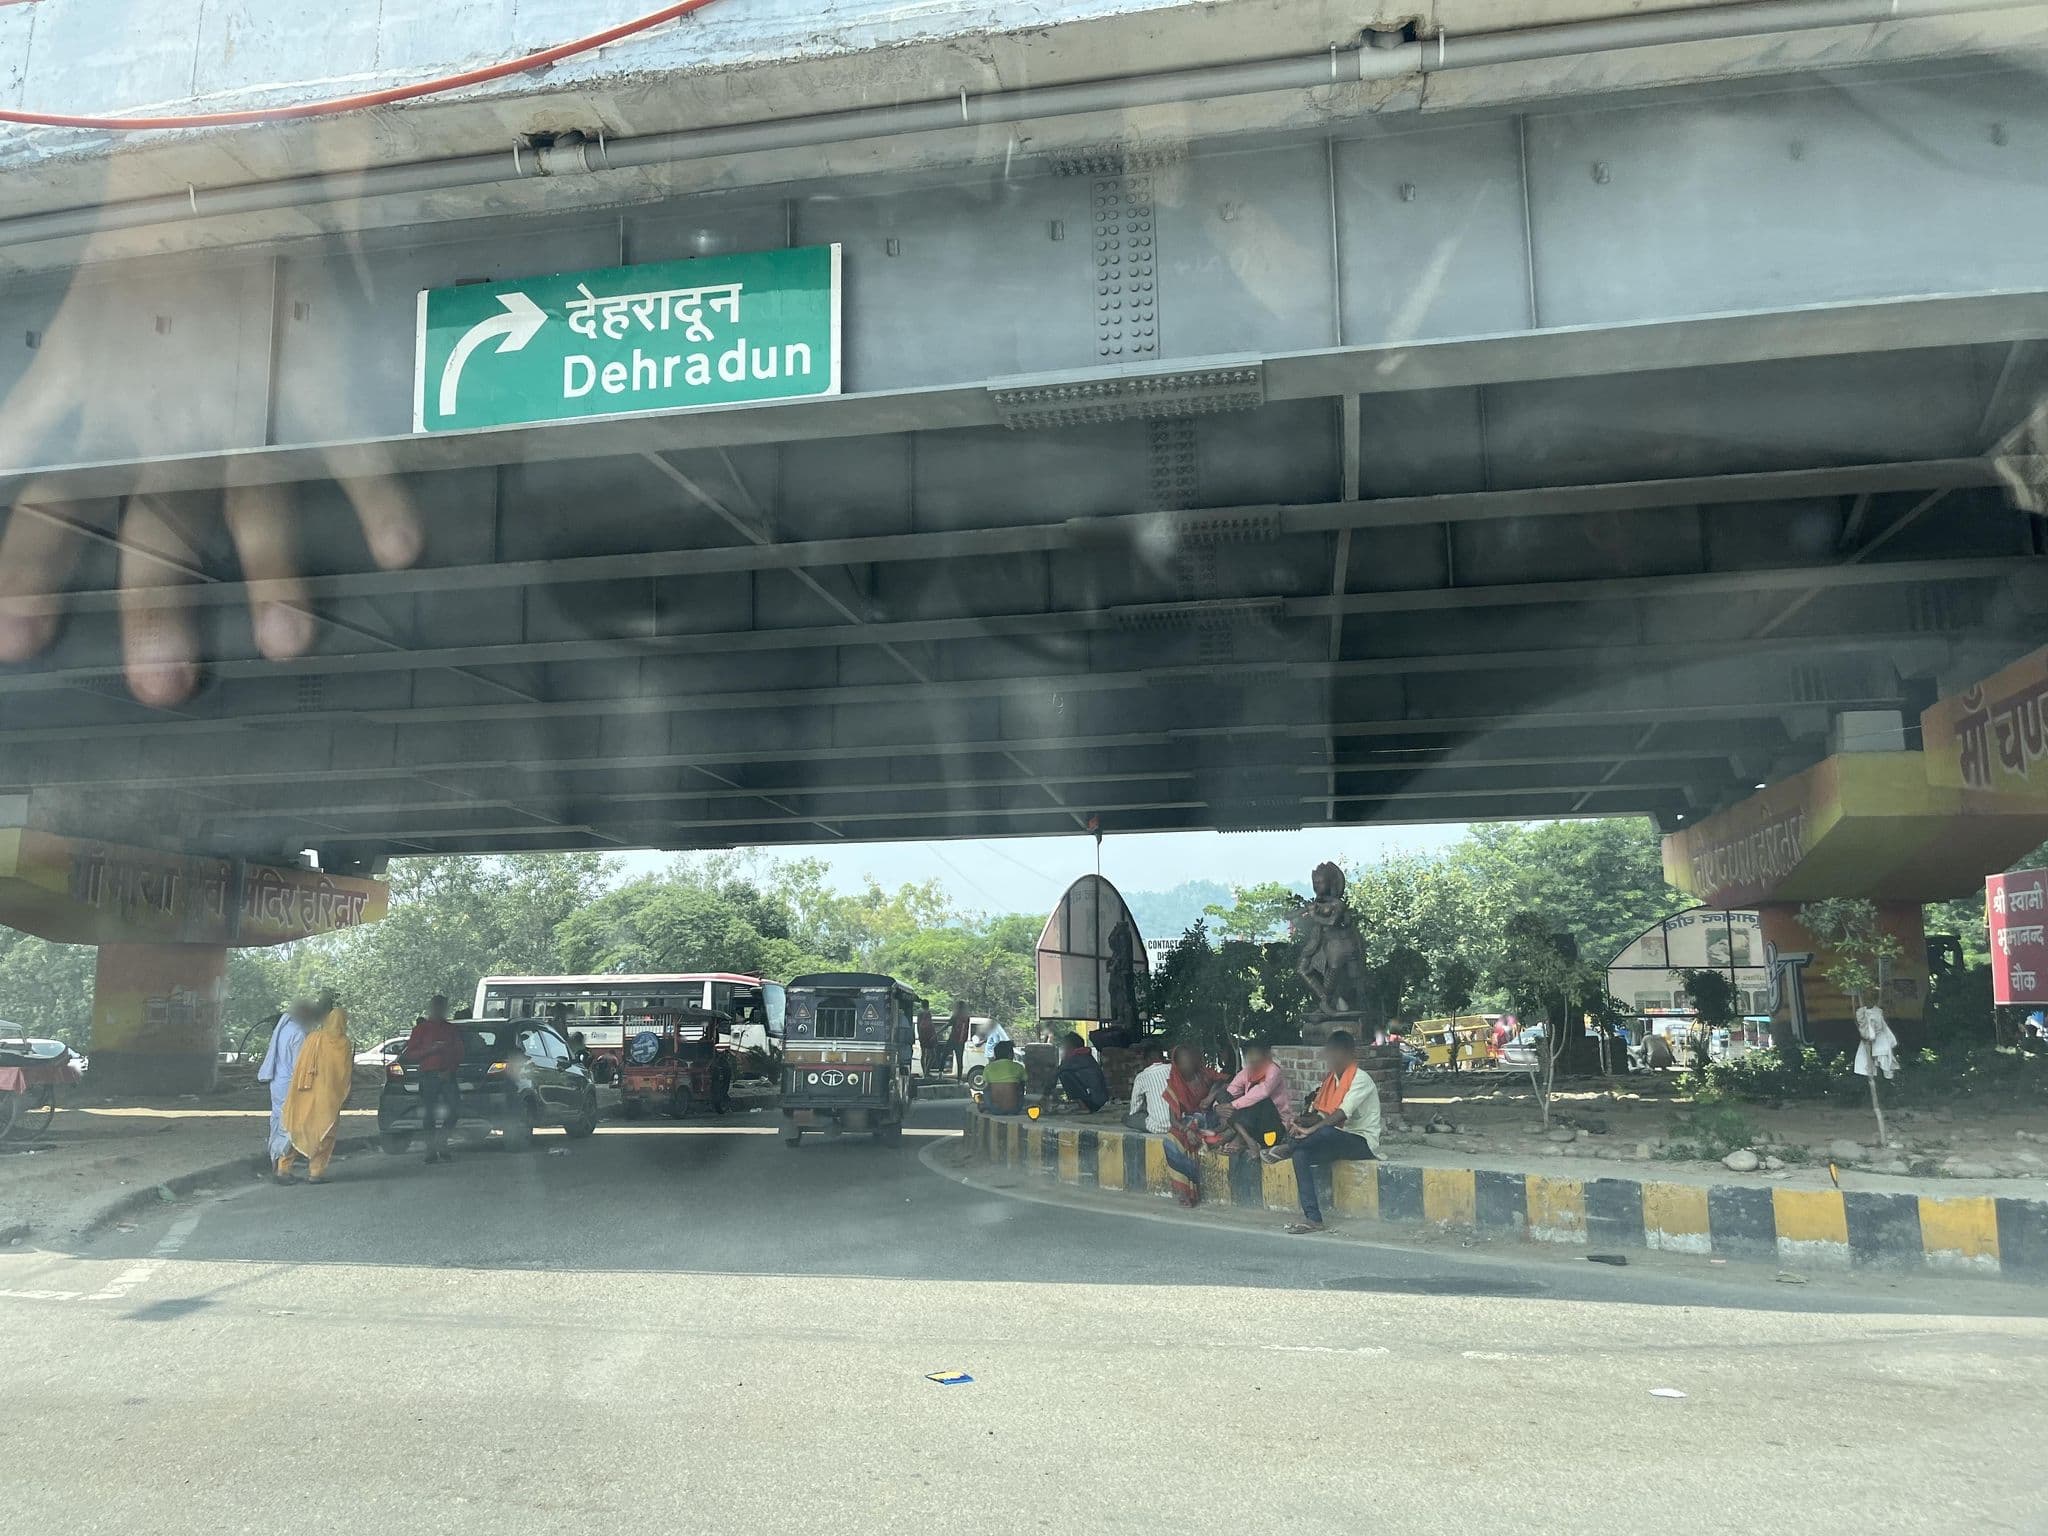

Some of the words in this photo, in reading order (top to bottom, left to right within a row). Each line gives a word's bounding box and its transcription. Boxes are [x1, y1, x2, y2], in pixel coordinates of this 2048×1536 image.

[566, 283, 744, 343] देहरादून
[563, 338, 811, 398] Dehradun
[296, 876, 369, 933] हरिद्वार
[1993, 886, 2006, 914] श्री
[2008, 881, 2044, 912] स्वामी
[1998, 925, 2044, 955] भूमानन्द
[2010, 963, 2036, 991] चौक
